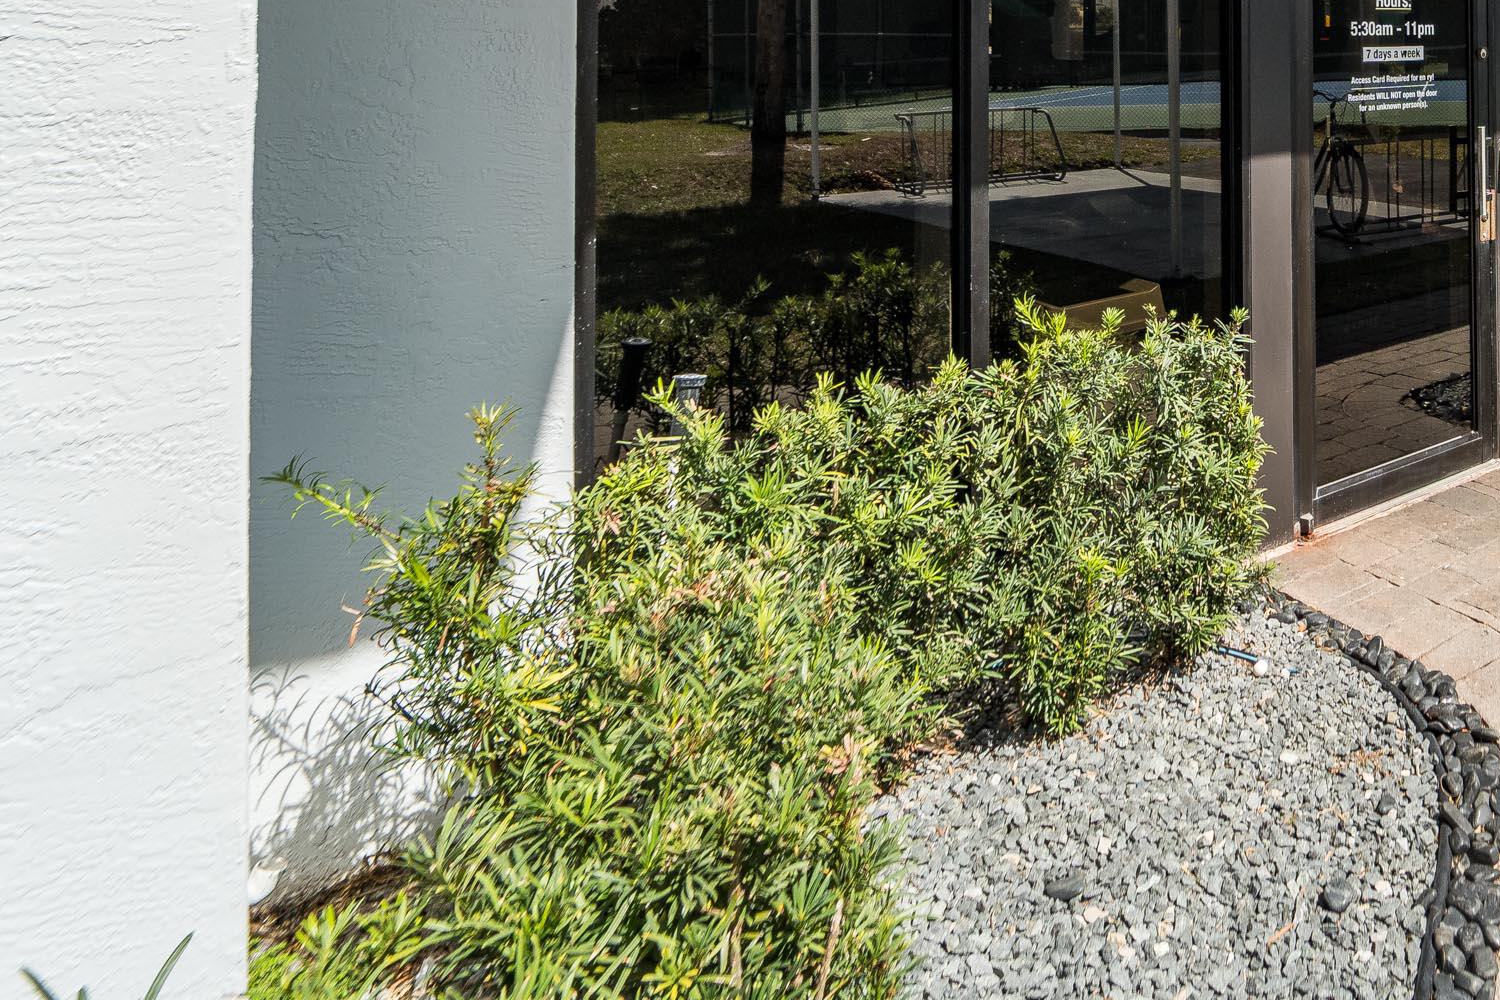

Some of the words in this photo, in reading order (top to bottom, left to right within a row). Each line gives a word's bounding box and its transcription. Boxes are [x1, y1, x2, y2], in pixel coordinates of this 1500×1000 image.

[1350, 21, 1394, 37] 5:30am
[1404, 21, 1435, 39] 11pm
[1366, 49, 1371, 58] 7
[1373, 48, 1392, 60] days
[1393, 50, 1398, 58] a
[1400, 48, 1421, 58] week
[1351, 76, 1371, 85] Access
[1372, 75, 1385, 83] Card
[1386, 74, 1410, 84] Required
[1410, 74, 1418, 82] for
[1348, 93, 1375, 102] Residents
[1376, 92, 1390, 100] WILL
[1390, 91, 1402, 99] NOT
[1402, 92, 1416, 100] open
[1426, 89, 1438, 97] door
[1359, 104, 1368, 112] for
[1376, 102, 1402, 111] unknown
